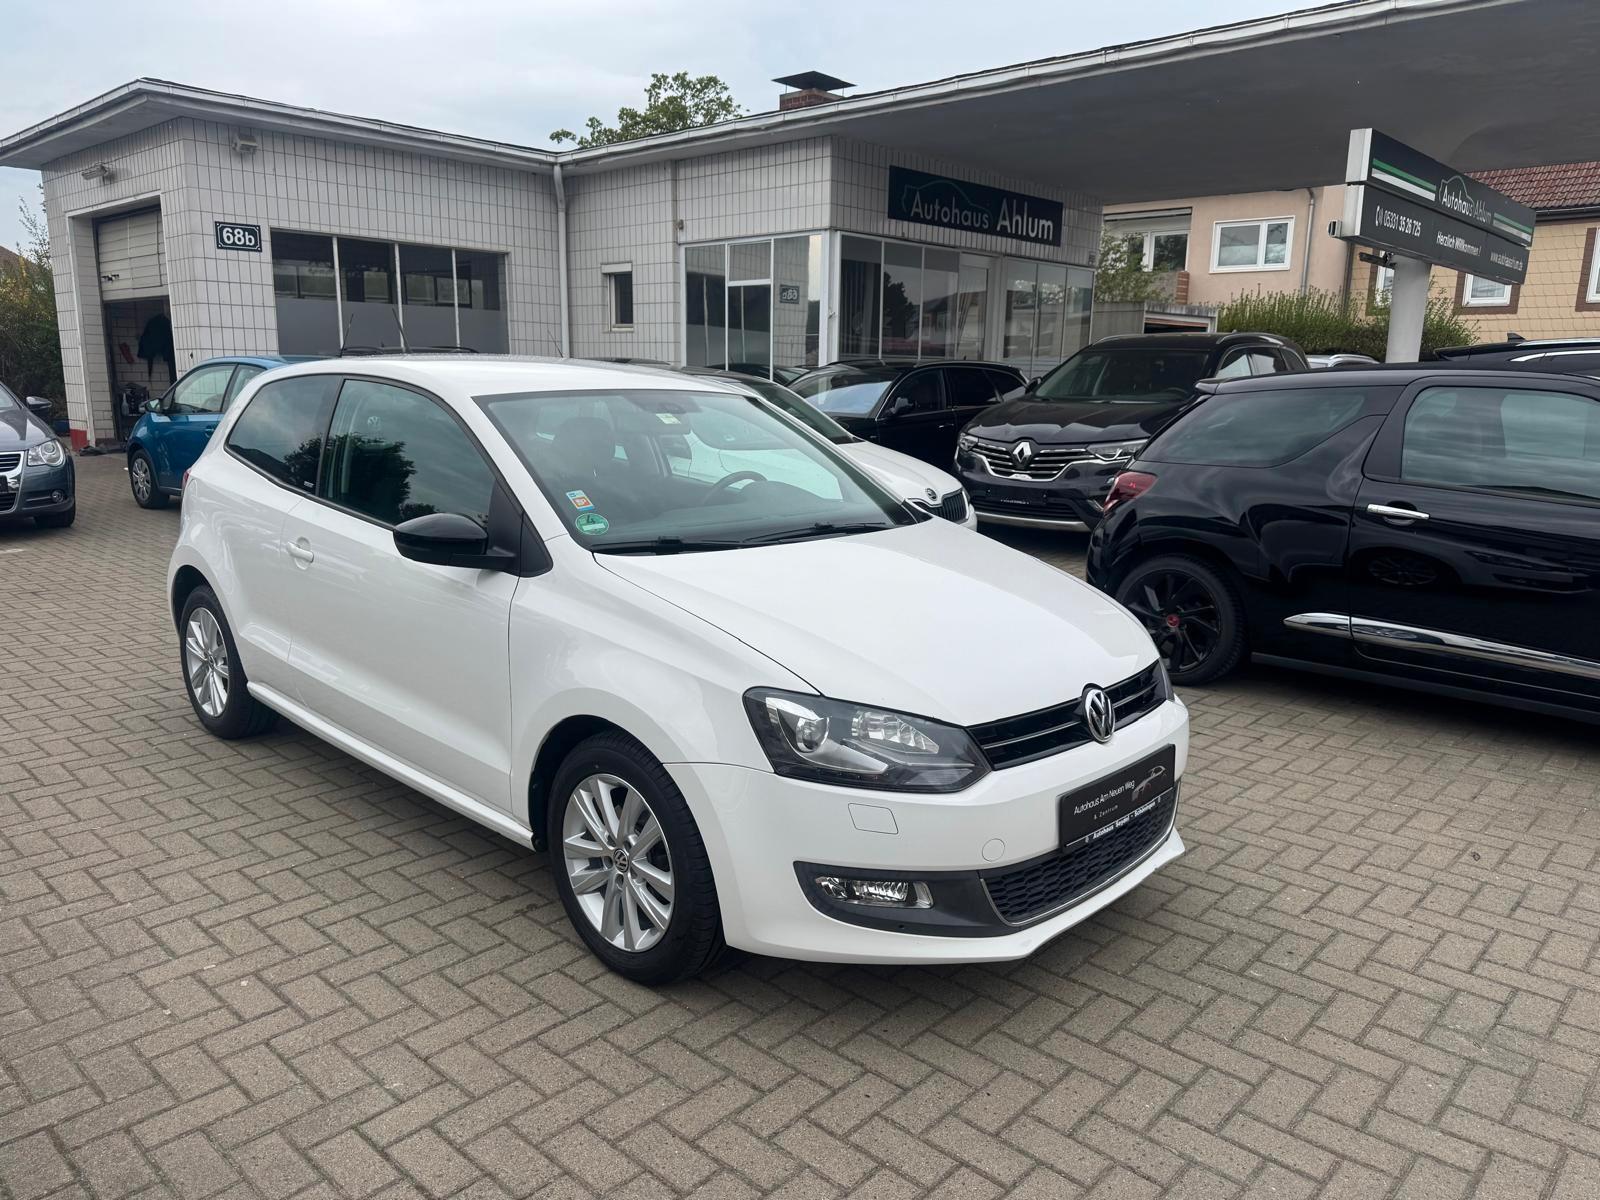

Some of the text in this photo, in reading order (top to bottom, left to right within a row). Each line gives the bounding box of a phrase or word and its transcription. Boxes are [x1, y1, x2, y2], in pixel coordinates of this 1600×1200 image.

[1441, 185, 1473, 217] Autohaus
[911, 190, 1054, 241] Autohaus Ahlum
[1383, 210, 1399, 230] 05331
[1399, 215, 1406, 232] 35
[1412, 219, 1421, 237] 725
[222, 227, 255, 246] 68b
[1436, 231, 1455, 249] Herzlich
[1073, 797, 1100, 815] Autohaus
[1099, 793, 1109, 803] Am
[1109, 785, 1125, 798] Neuen
